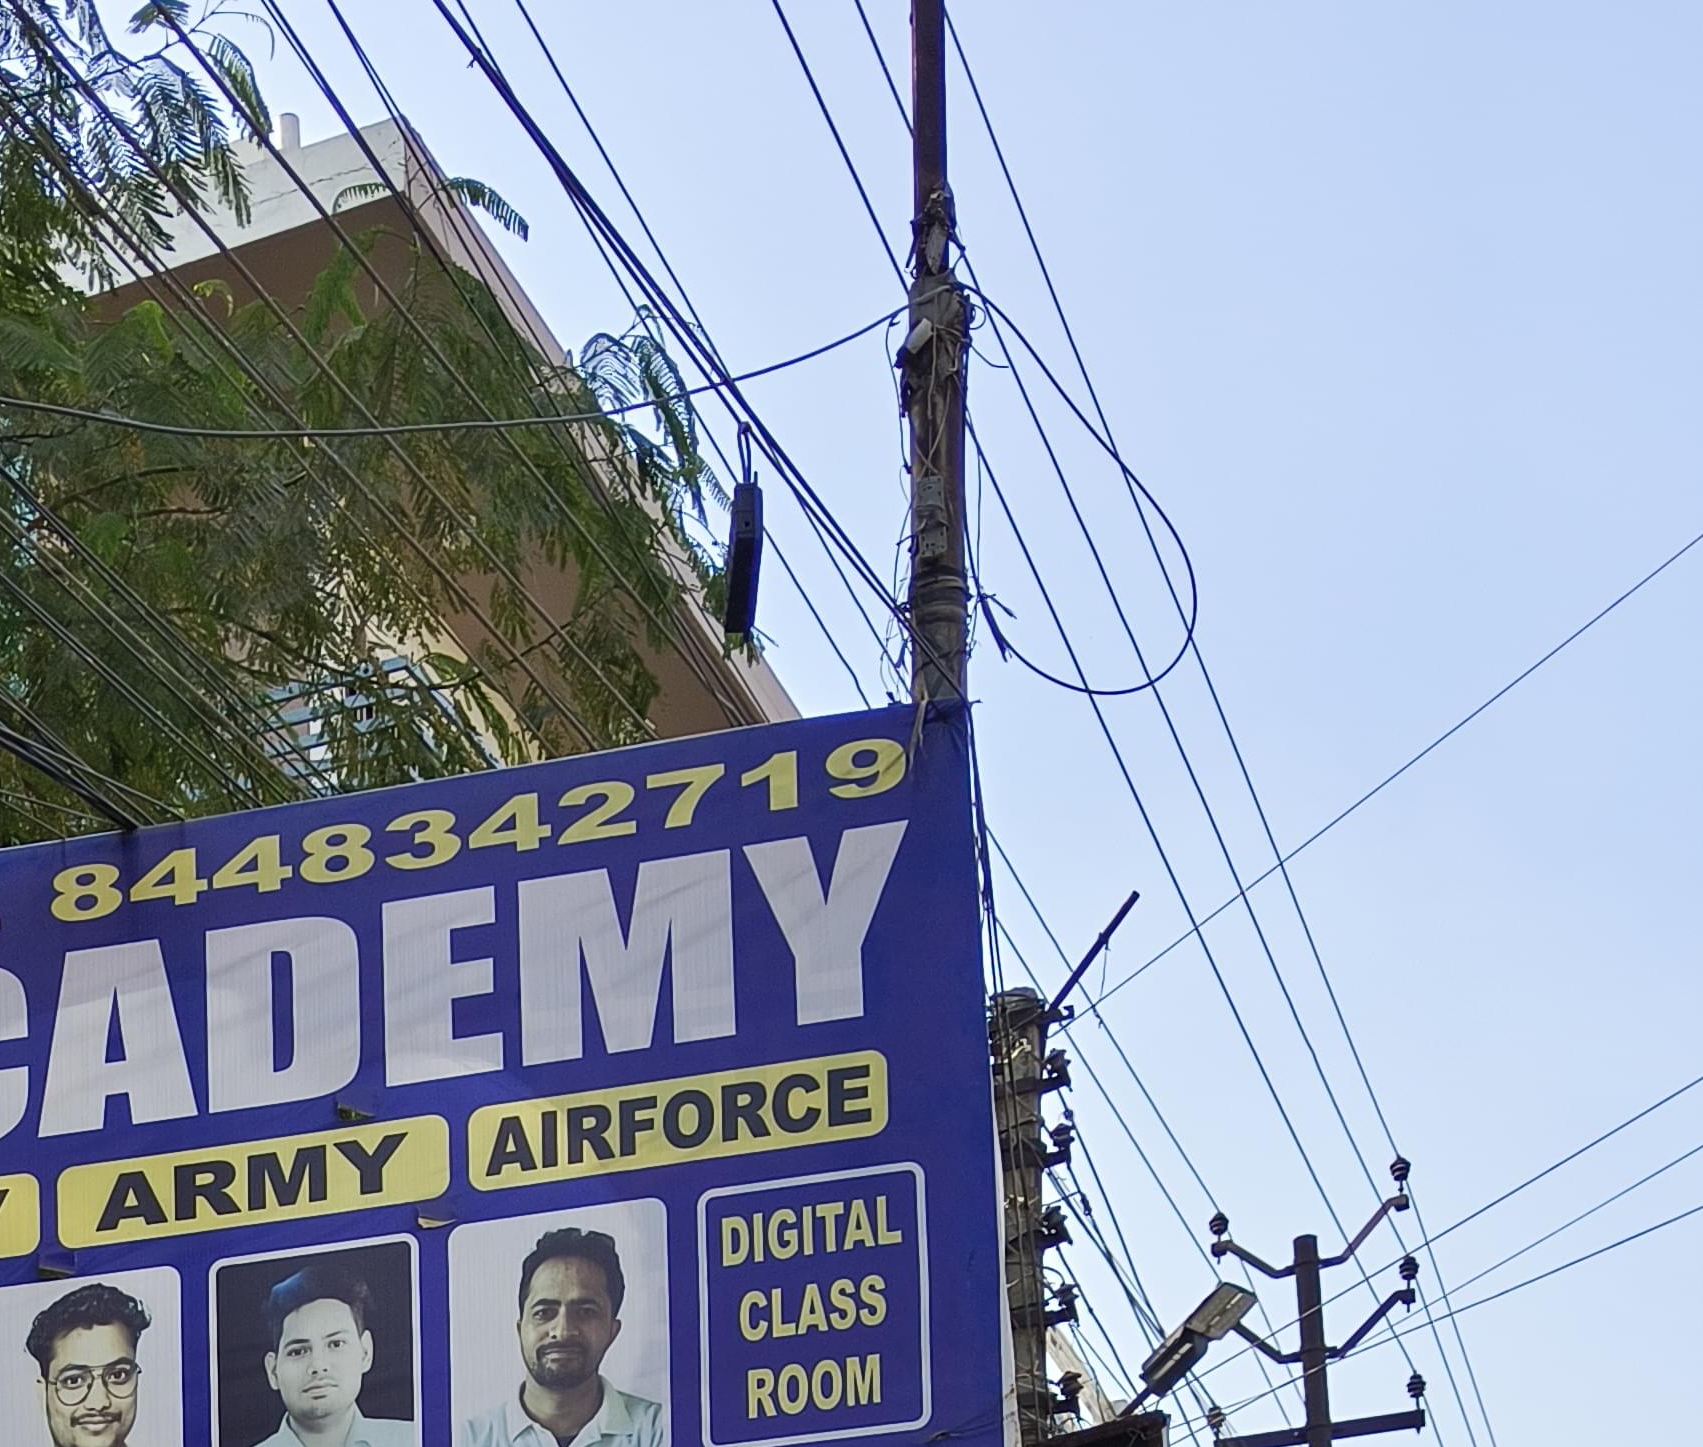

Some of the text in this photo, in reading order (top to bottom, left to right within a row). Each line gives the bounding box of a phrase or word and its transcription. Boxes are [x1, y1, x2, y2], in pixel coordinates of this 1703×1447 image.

[51, 738, 906, 922] 8448342719
[485, 1065, 872, 1176] AIRFORCE
[96, 1132, 409, 1232] ARMY
[721, 1195, 902, 1267] DIGITAL
[738, 1275, 887, 1342] CLASS
[747, 1353, 881, 1418] ROOM
